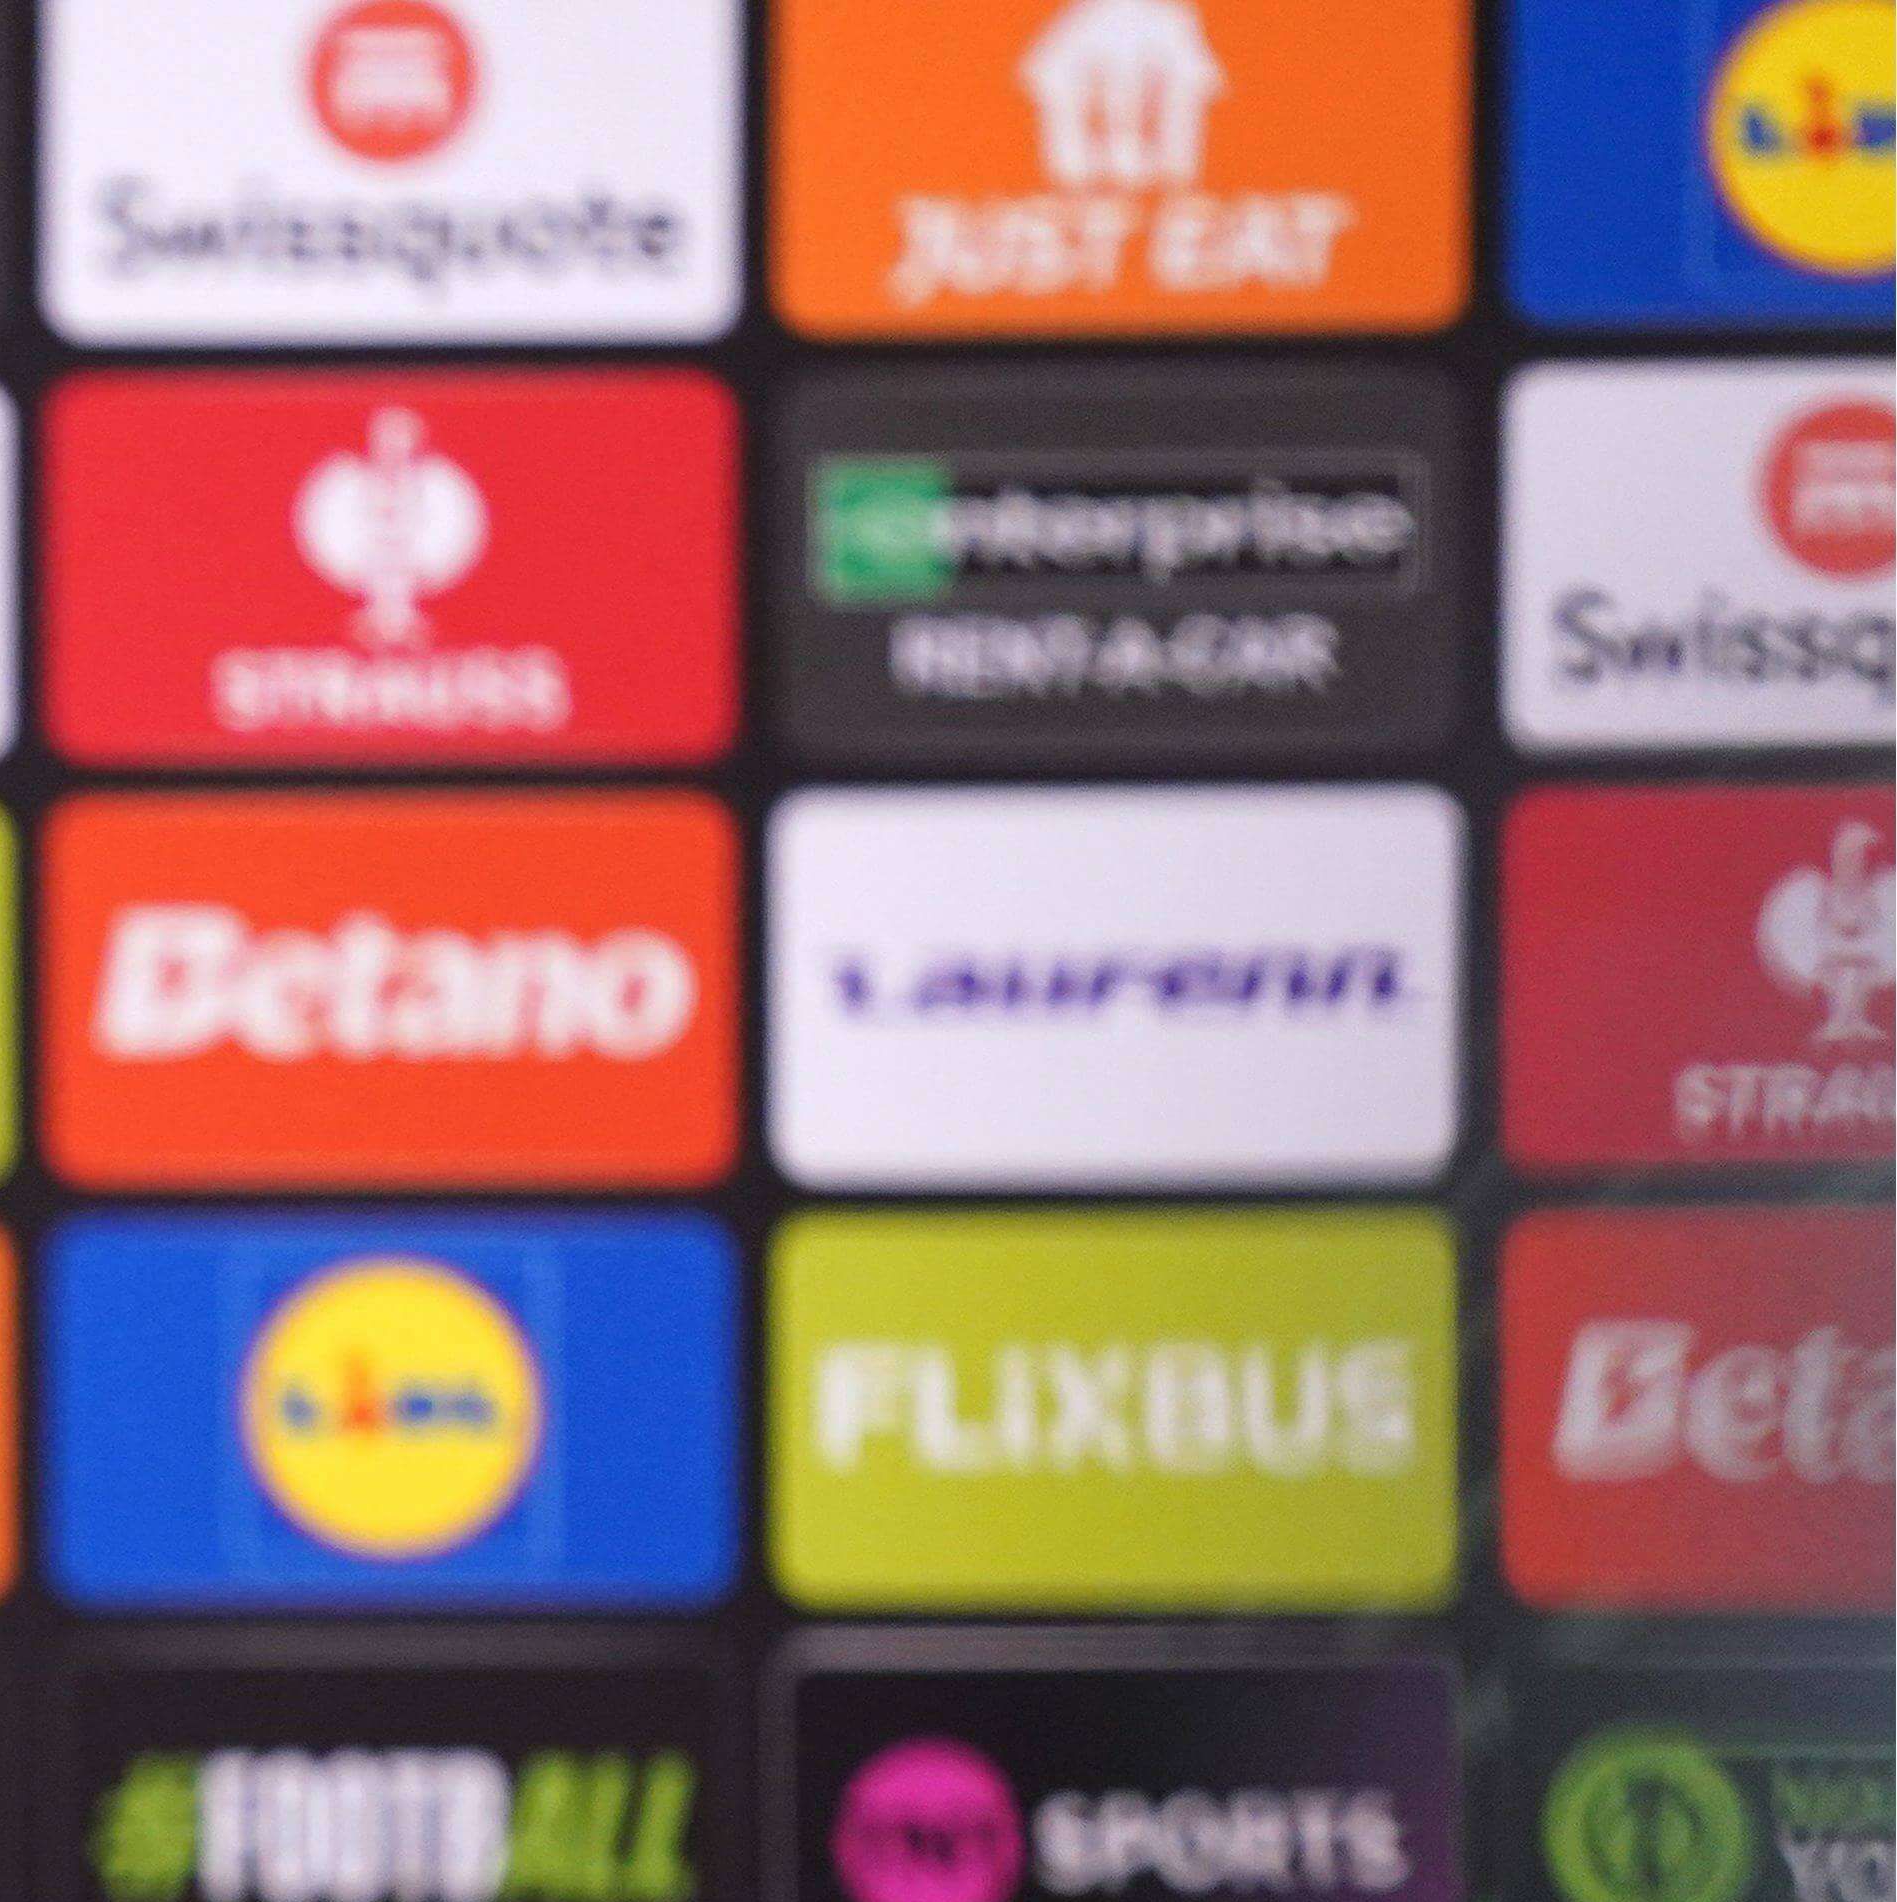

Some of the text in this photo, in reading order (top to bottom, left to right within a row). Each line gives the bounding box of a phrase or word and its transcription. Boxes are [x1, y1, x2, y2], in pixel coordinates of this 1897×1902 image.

[99, 176, 689, 300] Swissquote
[887, 193, 1355, 306] JUST EAT
[862, 478, 1413, 586] enterprise
[215, 648, 569, 732] STRAUSS
[93, 903, 698, 1060] Betano
[831, 945, 1411, 1018] Laurenn
[1034, 1791, 1411, 1894] SPORTS
